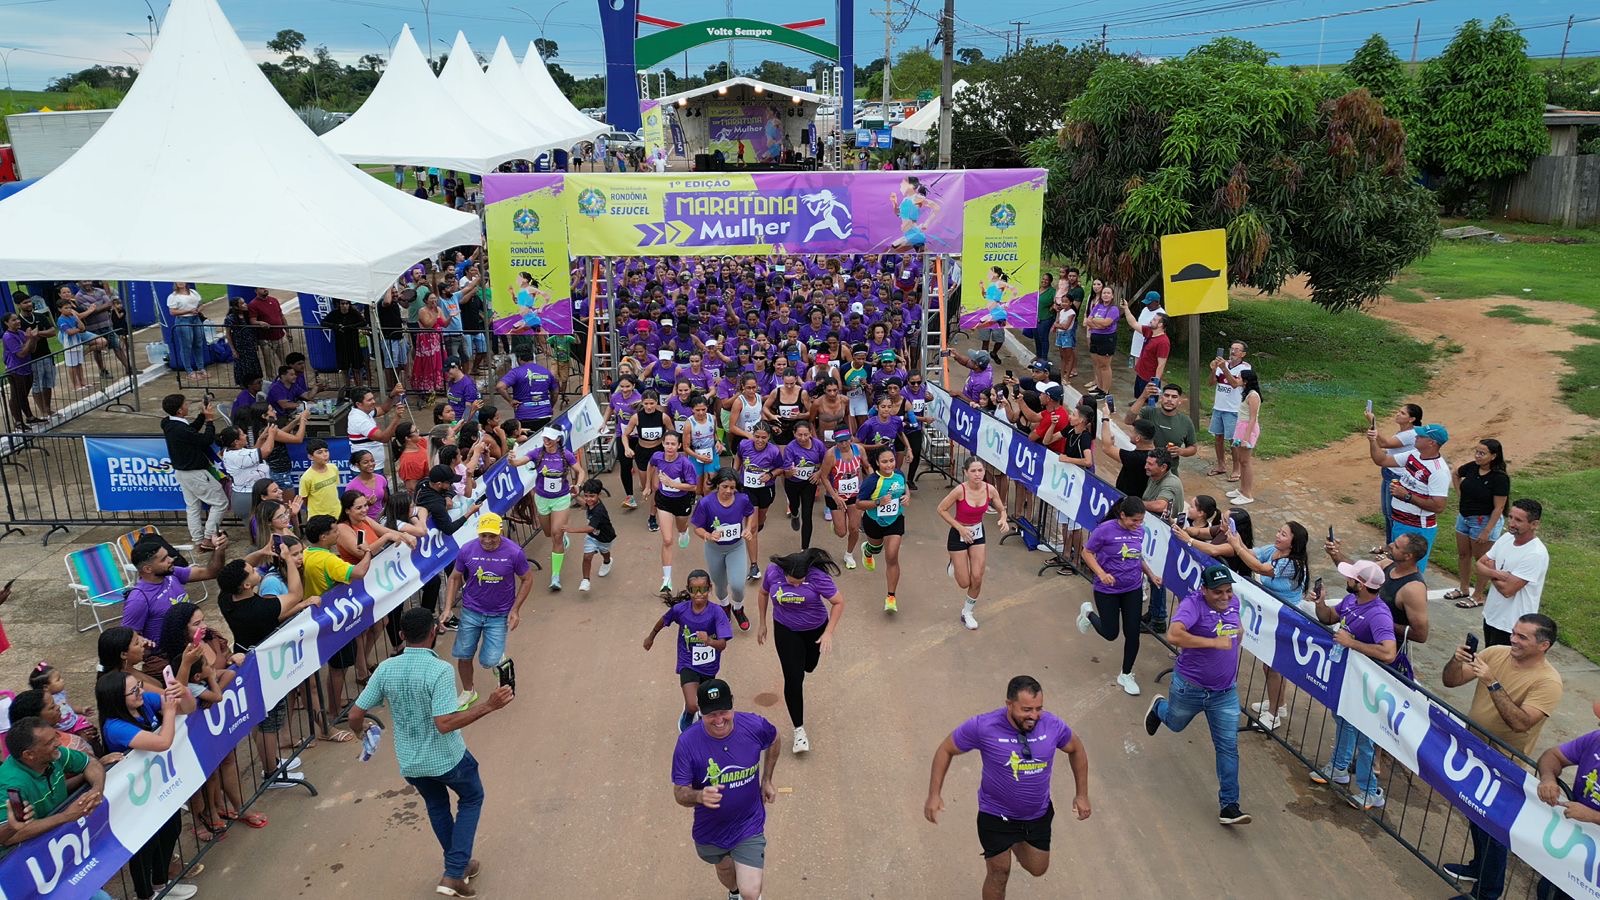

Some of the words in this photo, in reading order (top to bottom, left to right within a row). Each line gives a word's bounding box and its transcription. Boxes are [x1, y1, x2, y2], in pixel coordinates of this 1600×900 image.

[706, 27, 733, 36] Volte
[734, 27, 773, 37] Sempre
[685, 178, 731, 189] EDIÇÃO
[610, 192, 648, 201] RONDÔNIA
[676, 195, 798, 216] MARATONA
[610, 206, 650, 215] SEJUCEL
[699, 217, 791, 240] Mulher
[984, 240, 1018, 249] RONDÔNIA
[510, 246, 545, 254] RONDÔNIA
[983, 253, 1019, 262] SEJUCEL
[510, 258, 547, 267] SEJUCEL
[549, 482, 556, 490] 8
[840, 481, 858, 492] 363
[879, 503, 898, 514] 282
[693, 649, 714, 662] 301
